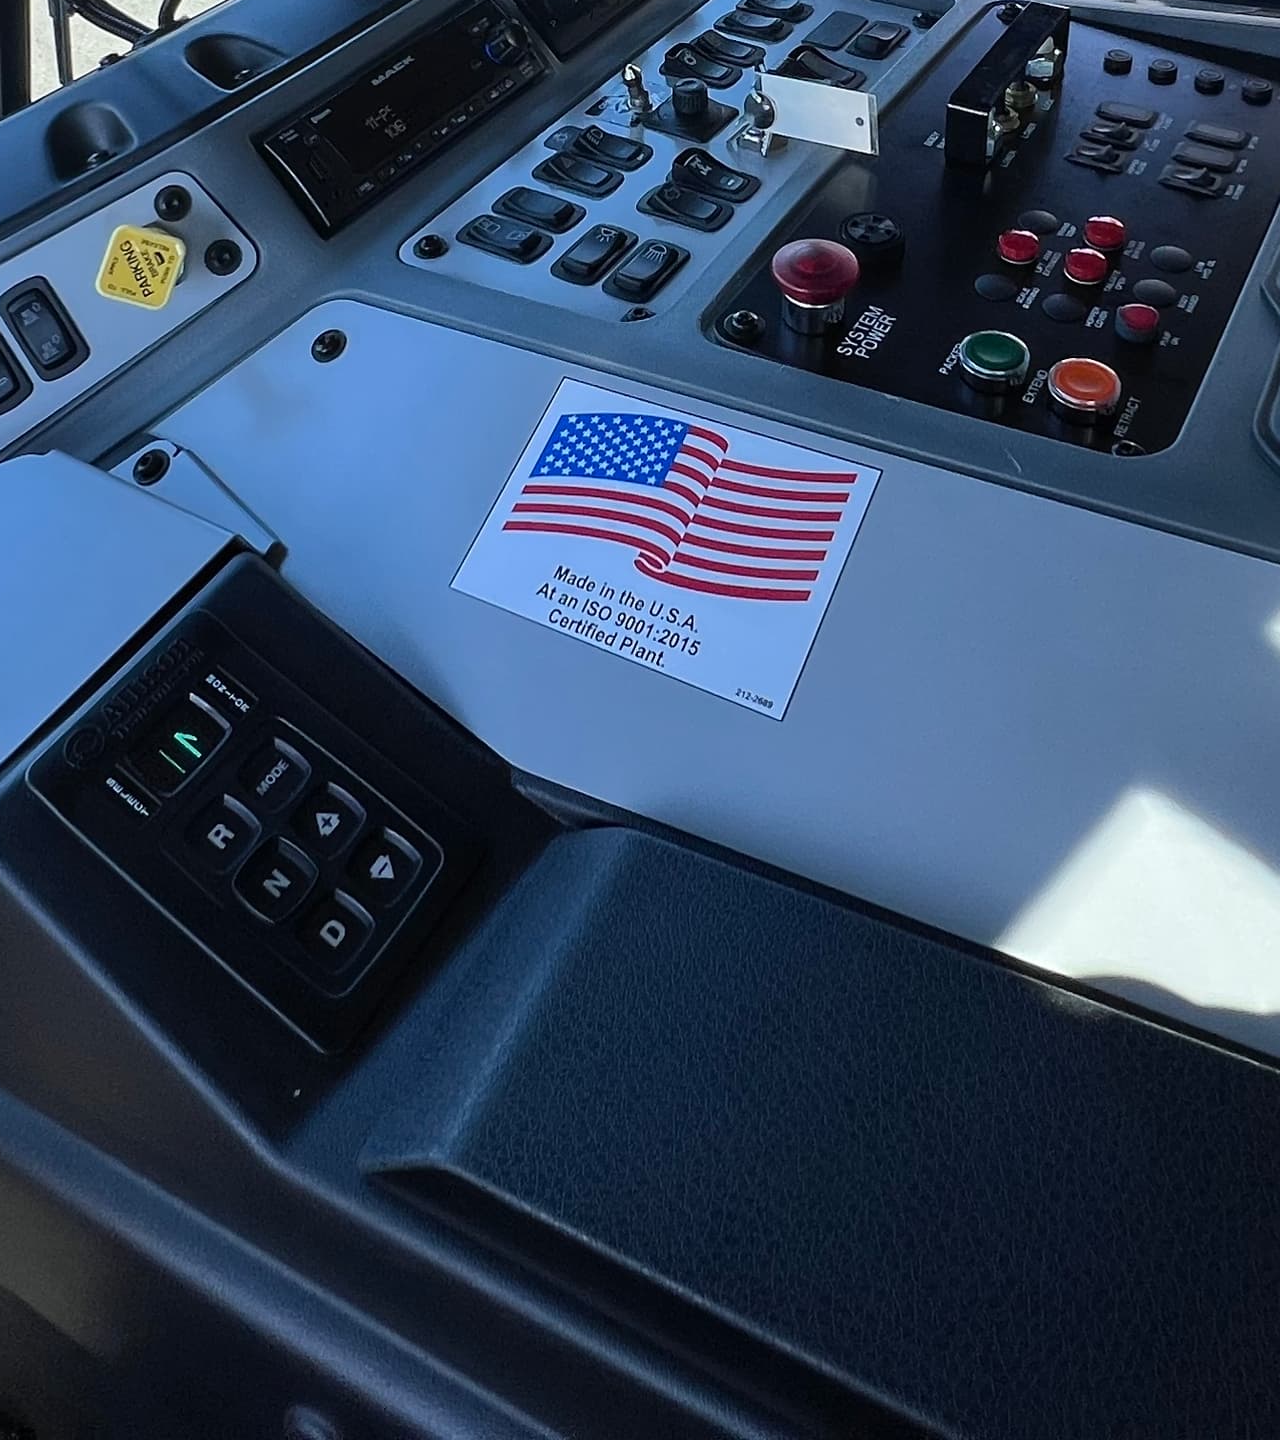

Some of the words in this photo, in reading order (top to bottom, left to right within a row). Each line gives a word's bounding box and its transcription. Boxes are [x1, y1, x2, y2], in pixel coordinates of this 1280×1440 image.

[371, 56, 415, 86] MACK
[120, 240, 155, 298] PARKING
[140, 249, 159, 278] BRAKE
[836, 305, 884, 356] SYSTEM
[855, 314, 897, 359] POWER
[1022, 369, 1049, 404] EXTEND
[1113, 396, 1143, 438] RETRACT
[553, 565, 596, 592] Made
[600, 581, 615, 600] in
[619, 590, 645, 611] the
[649, 601, 699, 633] U.S.A.
[536, 582, 556, 601] At
[558, 593, 579, 609] an
[581, 598, 613, 622] ISO
[615, 613, 701, 657] 9001:2015
[548, 609, 618, 647] Certified
[620, 637, 665, 668] Plant.
[205, 673, 251, 713] MONITOR
[105, 777, 150, 816] SELECT
[256, 760, 289, 796] MODE
[207, 823, 236, 851] R
[263, 867, 292, 898] N
[319, 919, 347, 948] D
